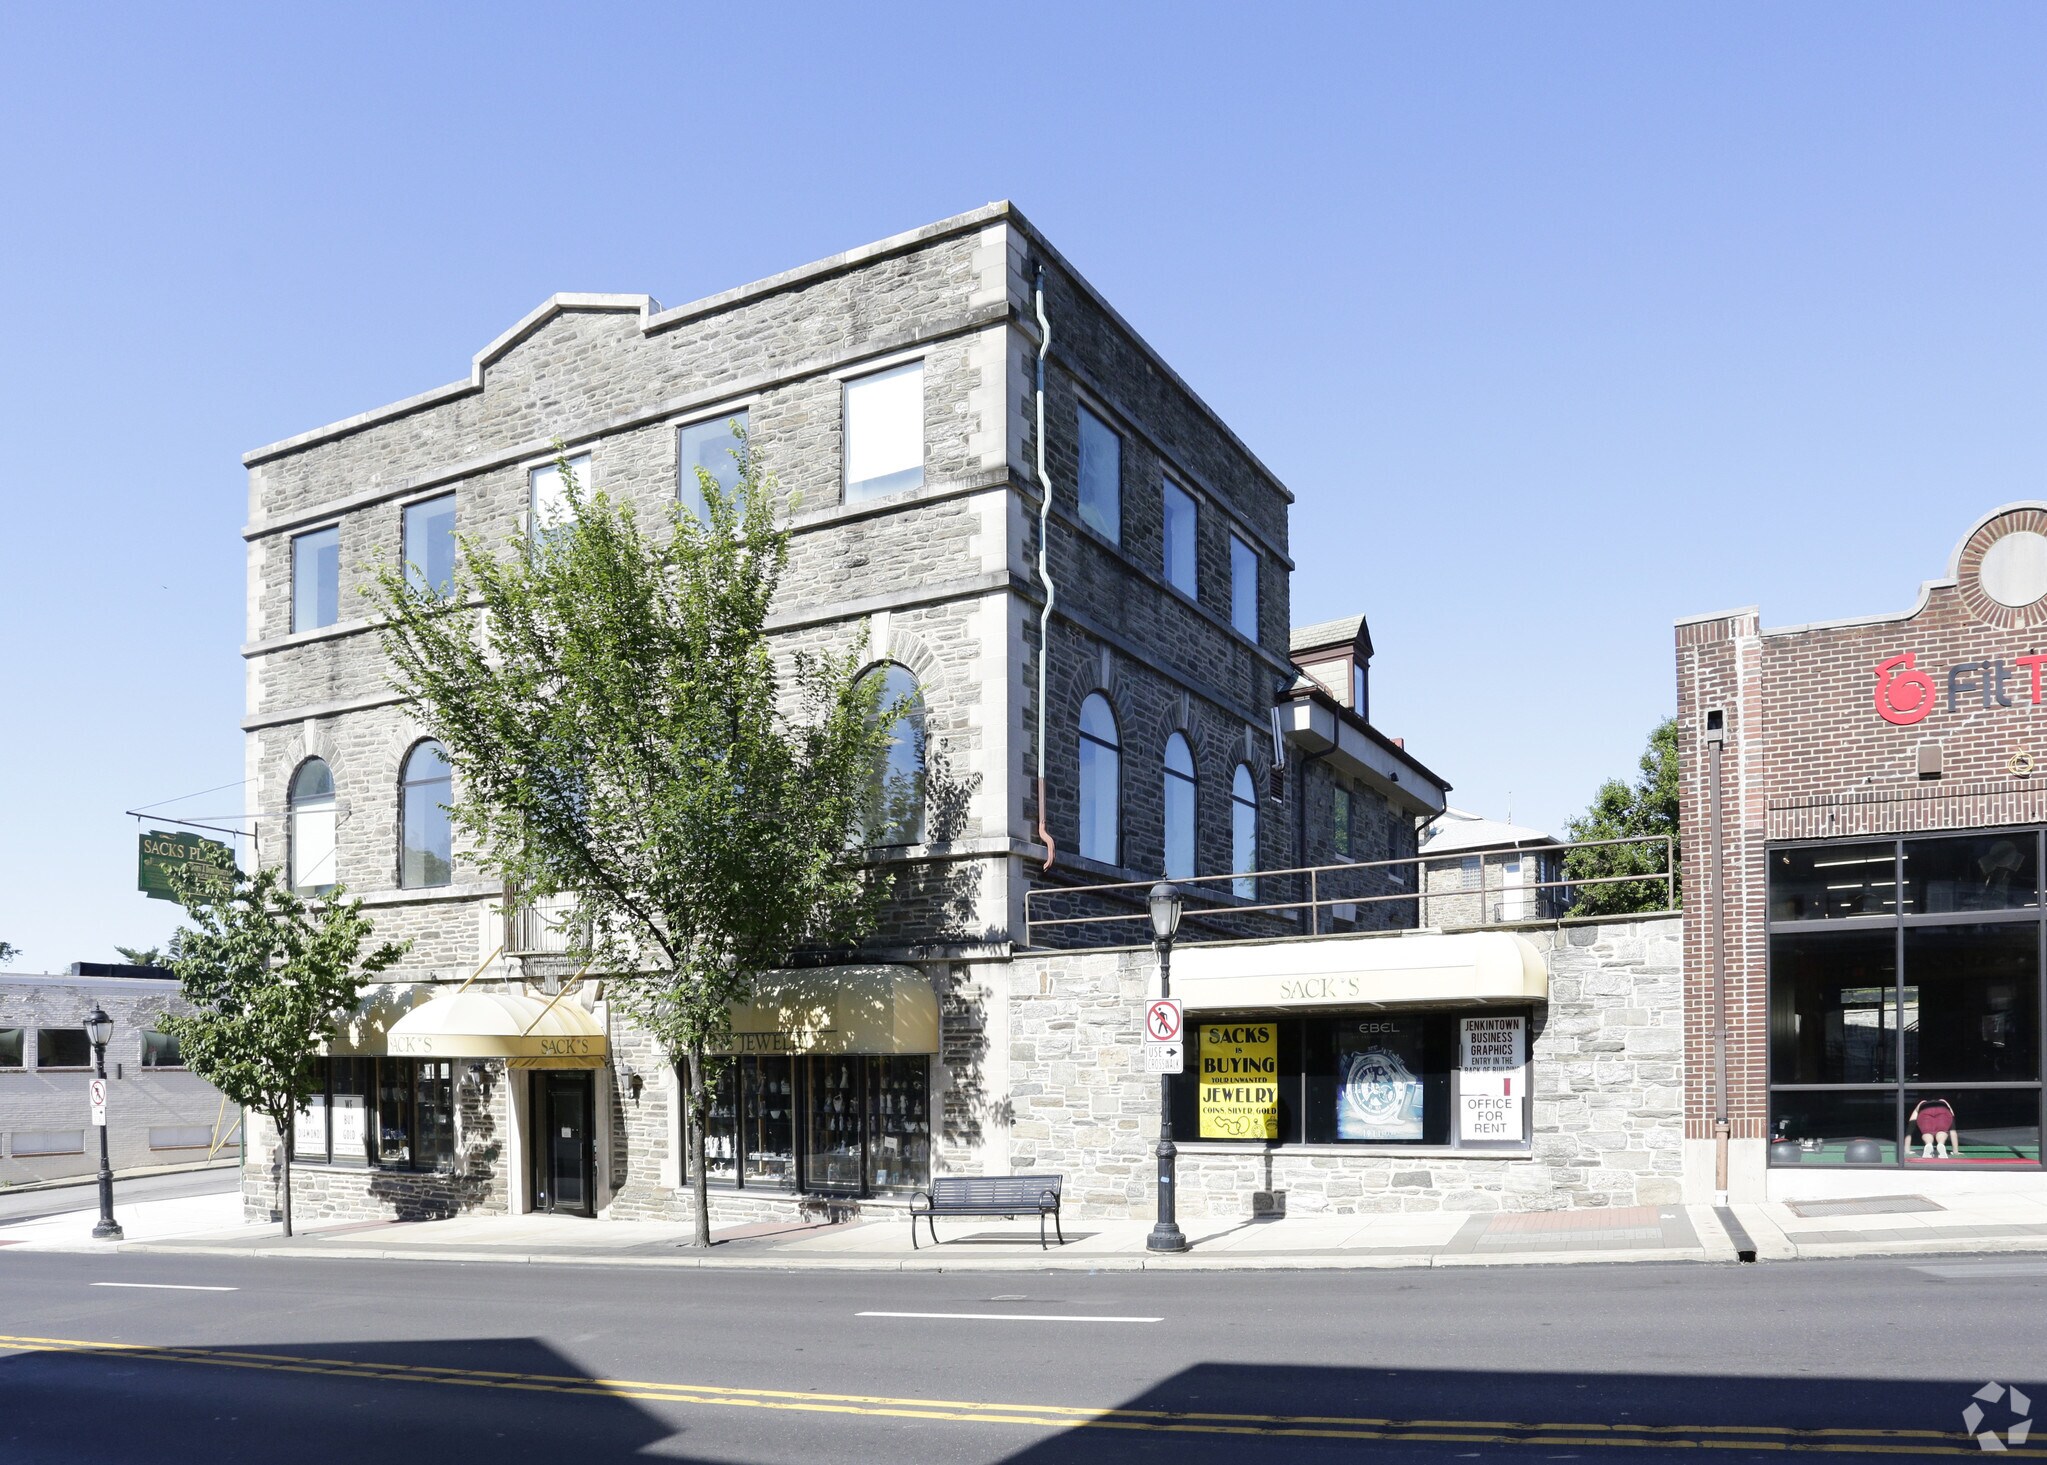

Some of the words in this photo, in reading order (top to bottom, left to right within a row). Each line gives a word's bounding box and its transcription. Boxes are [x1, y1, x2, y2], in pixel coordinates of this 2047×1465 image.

[144, 839, 185, 859] SACKS
[1359, 1023, 1400, 1033] EBEL
[1465, 1019, 1519, 1031] JENKINTOWN
[1209, 1027, 1270, 1044] SACKS
[1471, 1032, 1513, 1043] BUSINESS
[1148, 1046, 1162, 1058] USE
[1471, 1044, 1513, 1056] GRAPHICS
[1147, 1058, 1179, 1070] CROSSWALK
[1204, 1057, 1275, 1073] BUYING
[1471, 1057, 1491, 1066] ENTRY
[1493, 1057, 1500, 1065] IN
[1502, 1057, 1513, 1065] THE
[1203, 1087, 1276, 1103] JEWELRY
[344, 1100, 353, 1109] WE
[1468, 1098, 1512, 1109] OFFICE
[343, 1114, 354, 1125] BUY
[1477, 1111, 1503, 1121] FOR
[1474, 1123, 1507, 1133] RENT
[342, 1129, 356, 1140] GOLD
